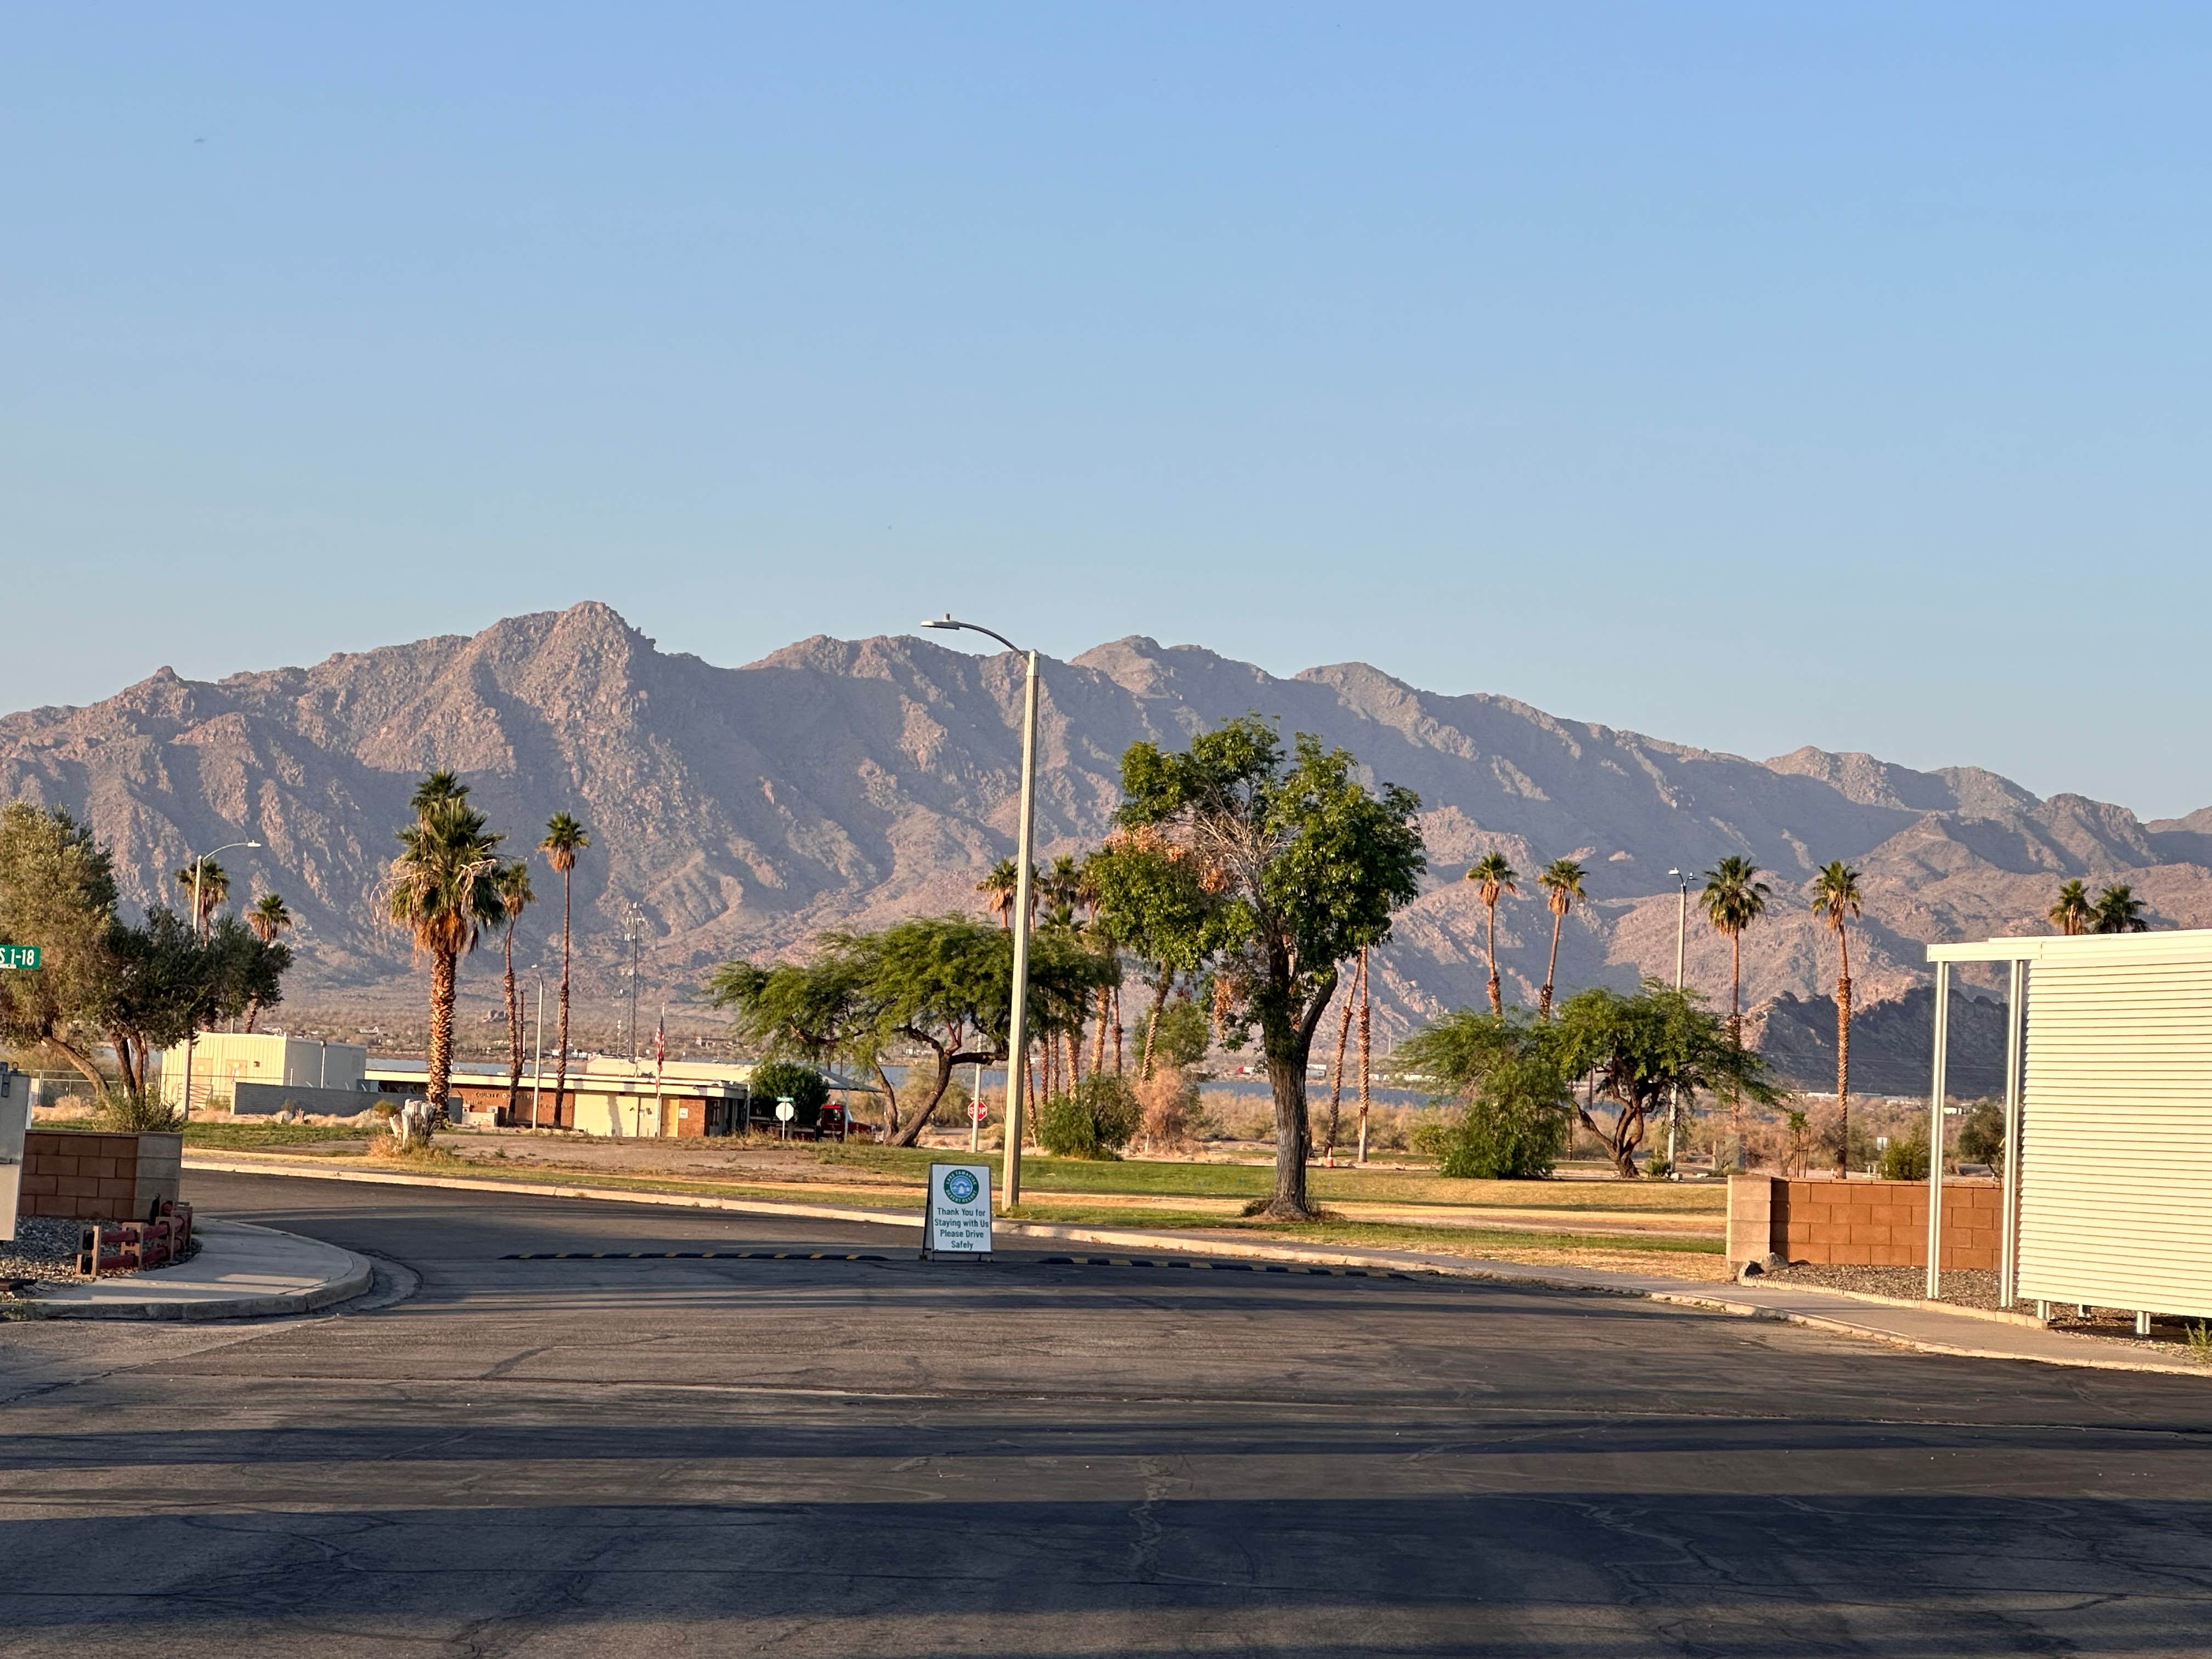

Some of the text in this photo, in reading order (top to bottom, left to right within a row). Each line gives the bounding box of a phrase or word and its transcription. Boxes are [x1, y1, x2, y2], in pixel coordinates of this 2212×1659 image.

[11, 949, 35, 966] 1-18
[946, 1173, 955, 1184] LAKE
[962, 1190, 977, 1203] RESORT
[961, 1208, 974, 1216] You
[934, 1218, 961, 1228] Staying
[951, 1240, 973, 1250] Safely
